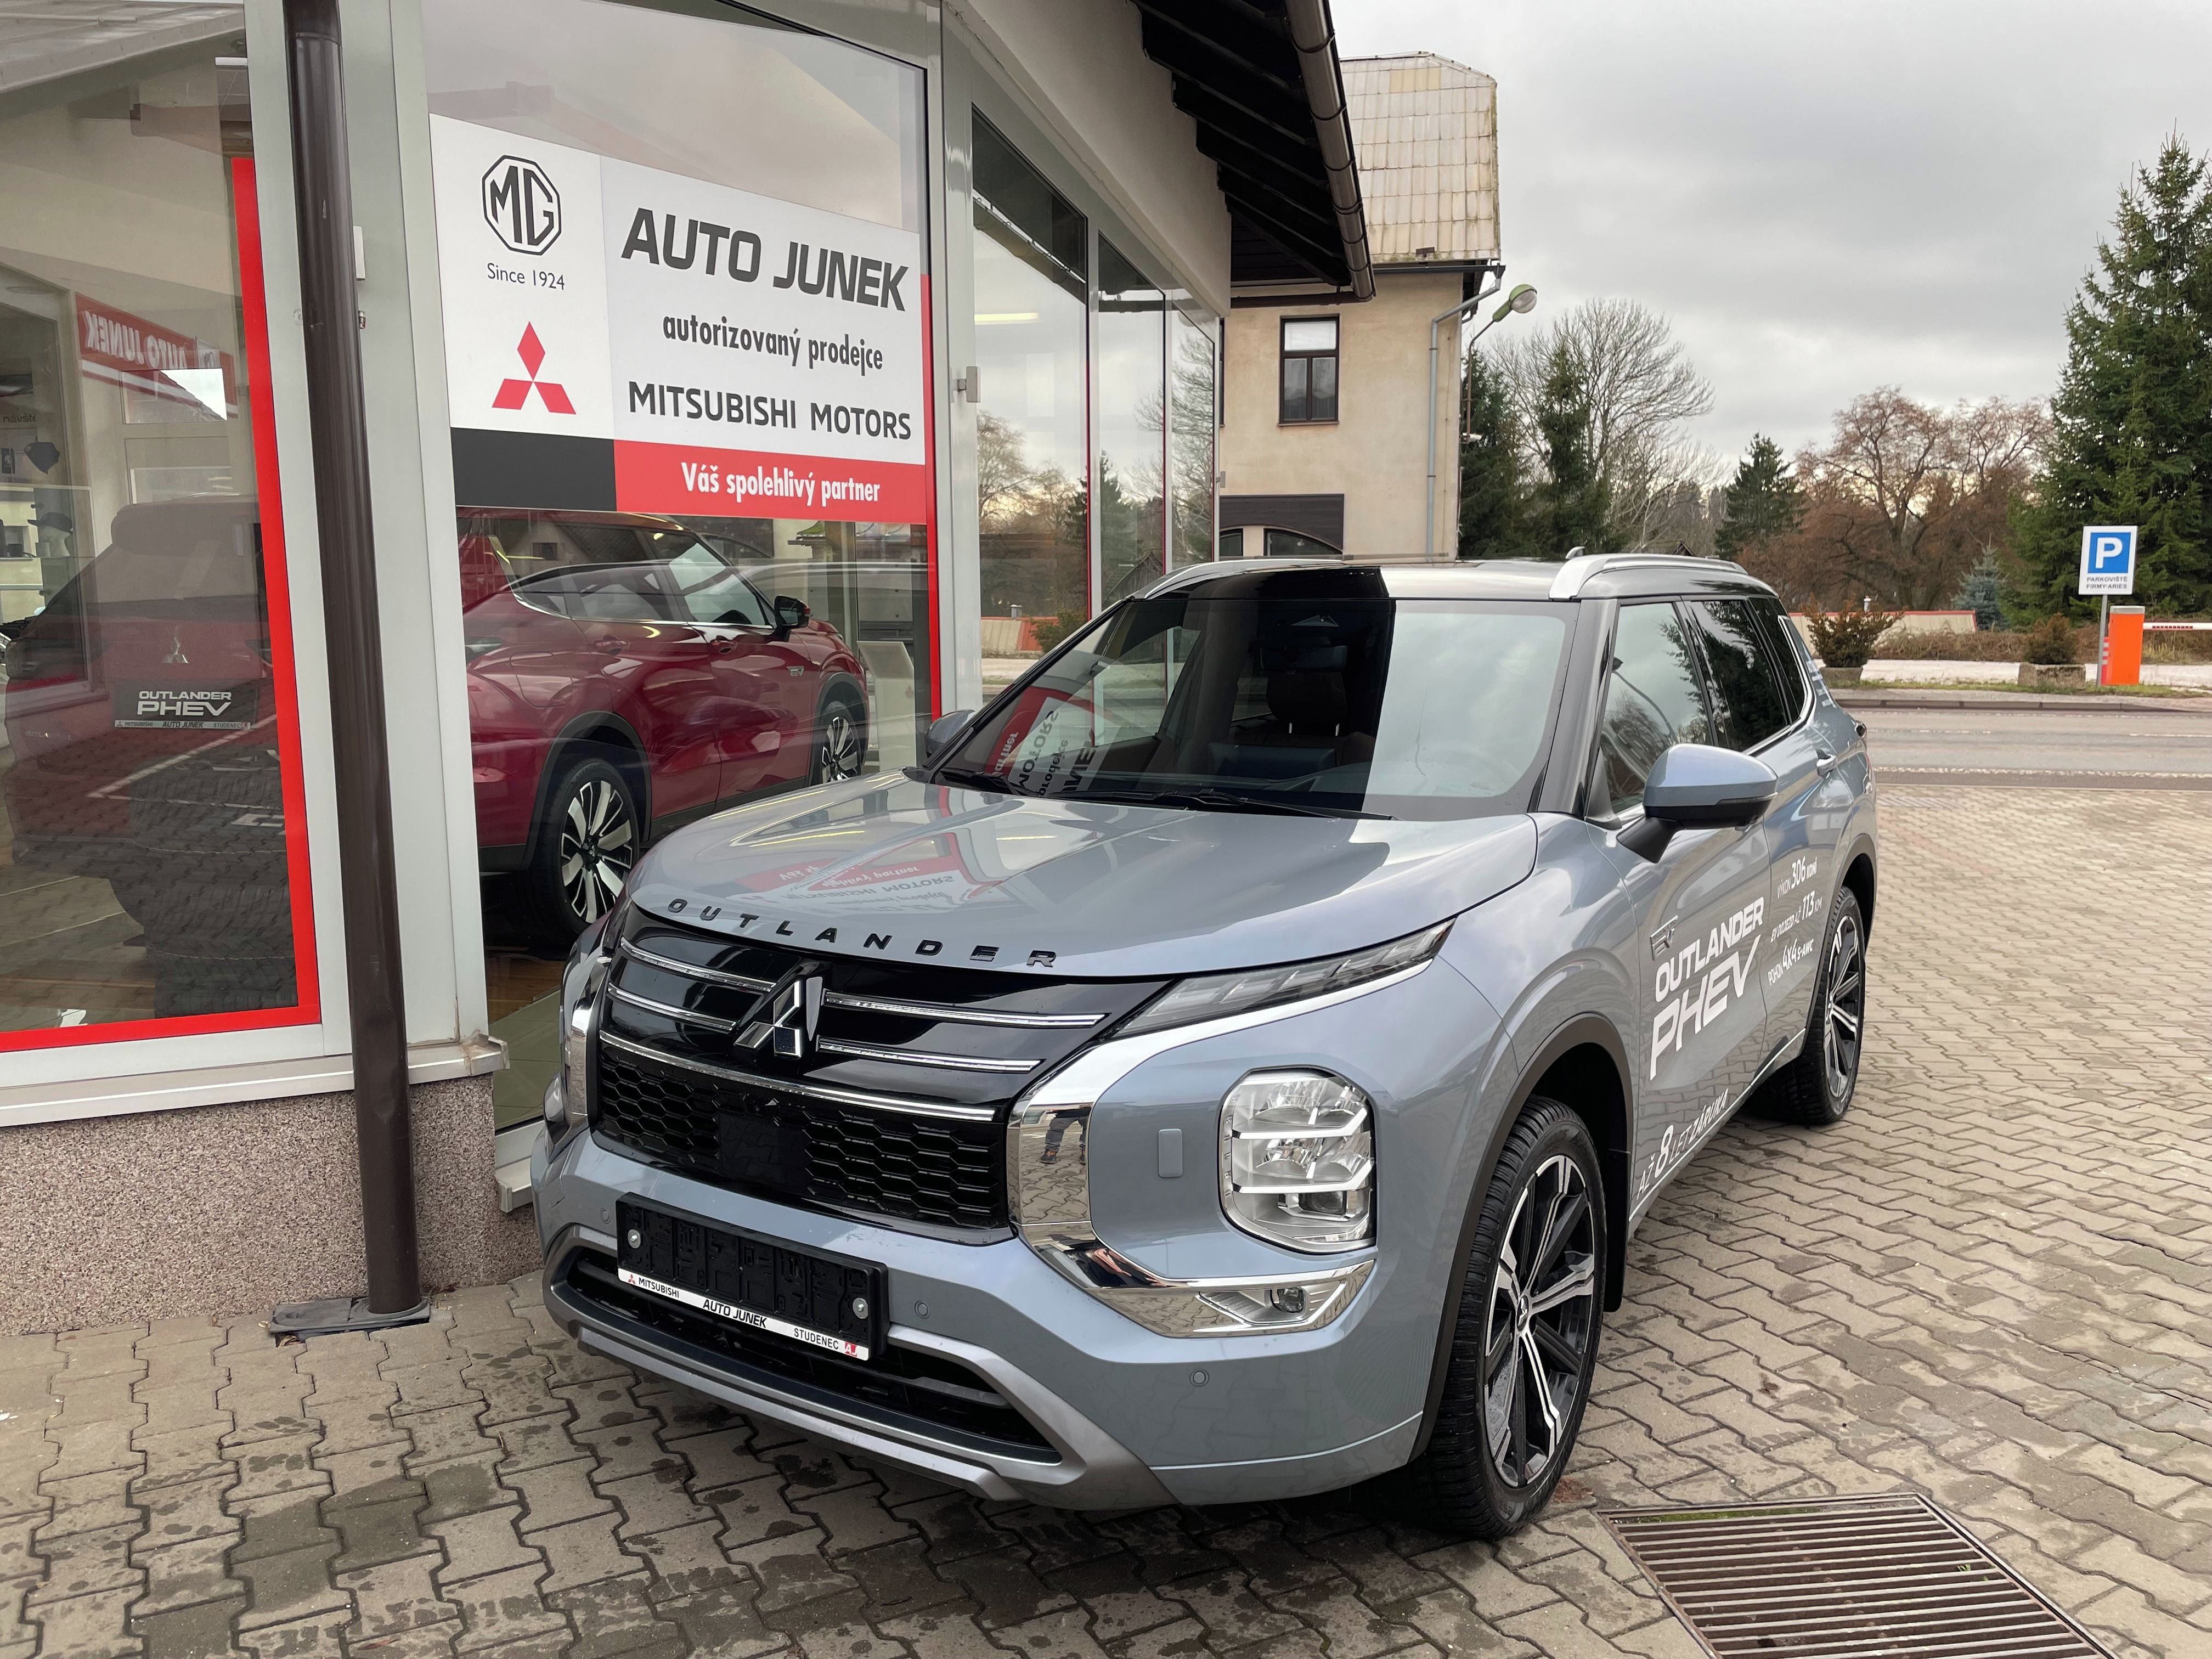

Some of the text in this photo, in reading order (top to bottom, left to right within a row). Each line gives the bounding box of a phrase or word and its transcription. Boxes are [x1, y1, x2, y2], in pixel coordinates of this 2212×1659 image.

[489, 165, 555, 246] MG
[487, 263, 565, 290] Since 1924
[620, 207, 910, 312] AUTO JUNEK
[663, 314, 883, 377] autorizovaný prodejce
[629, 380, 911, 440] MITSUBISHI MOTORS
[681, 461, 881, 507] Váš spolehlivý partner
[2095, 537, 2123, 569] P
[137, 701, 232, 716] PHEV
[139, 691, 232, 701] OUTLANDER
[1777, 855, 1818, 899] VÝKON 306 KONÍ
[668, 898, 1058, 968] OUTLANDER
[1770, 926, 1778, 943] EV
[1776, 913, 1795, 938] DOJEZD
[1802, 890, 1815, 921] 113
[1814, 896, 1823, 913] KM
[1656, 896, 1765, 1003] OUTLANDER
[1768, 960, 1784, 986] POHON
[1782, 938, 1798, 970] 4X4
[1650, 934, 1761, 1081] PHEV
[1637, 1088, 1729, 1200] AŽ 8 LET ZÁRUKA
[638, 1277, 680, 1299] MITSUBISHI
[702, 1299, 731, 1317] AUTO
[732, 1308, 768, 1329] JUNEK
[793, 1328, 839, 1351] STUDENEC
